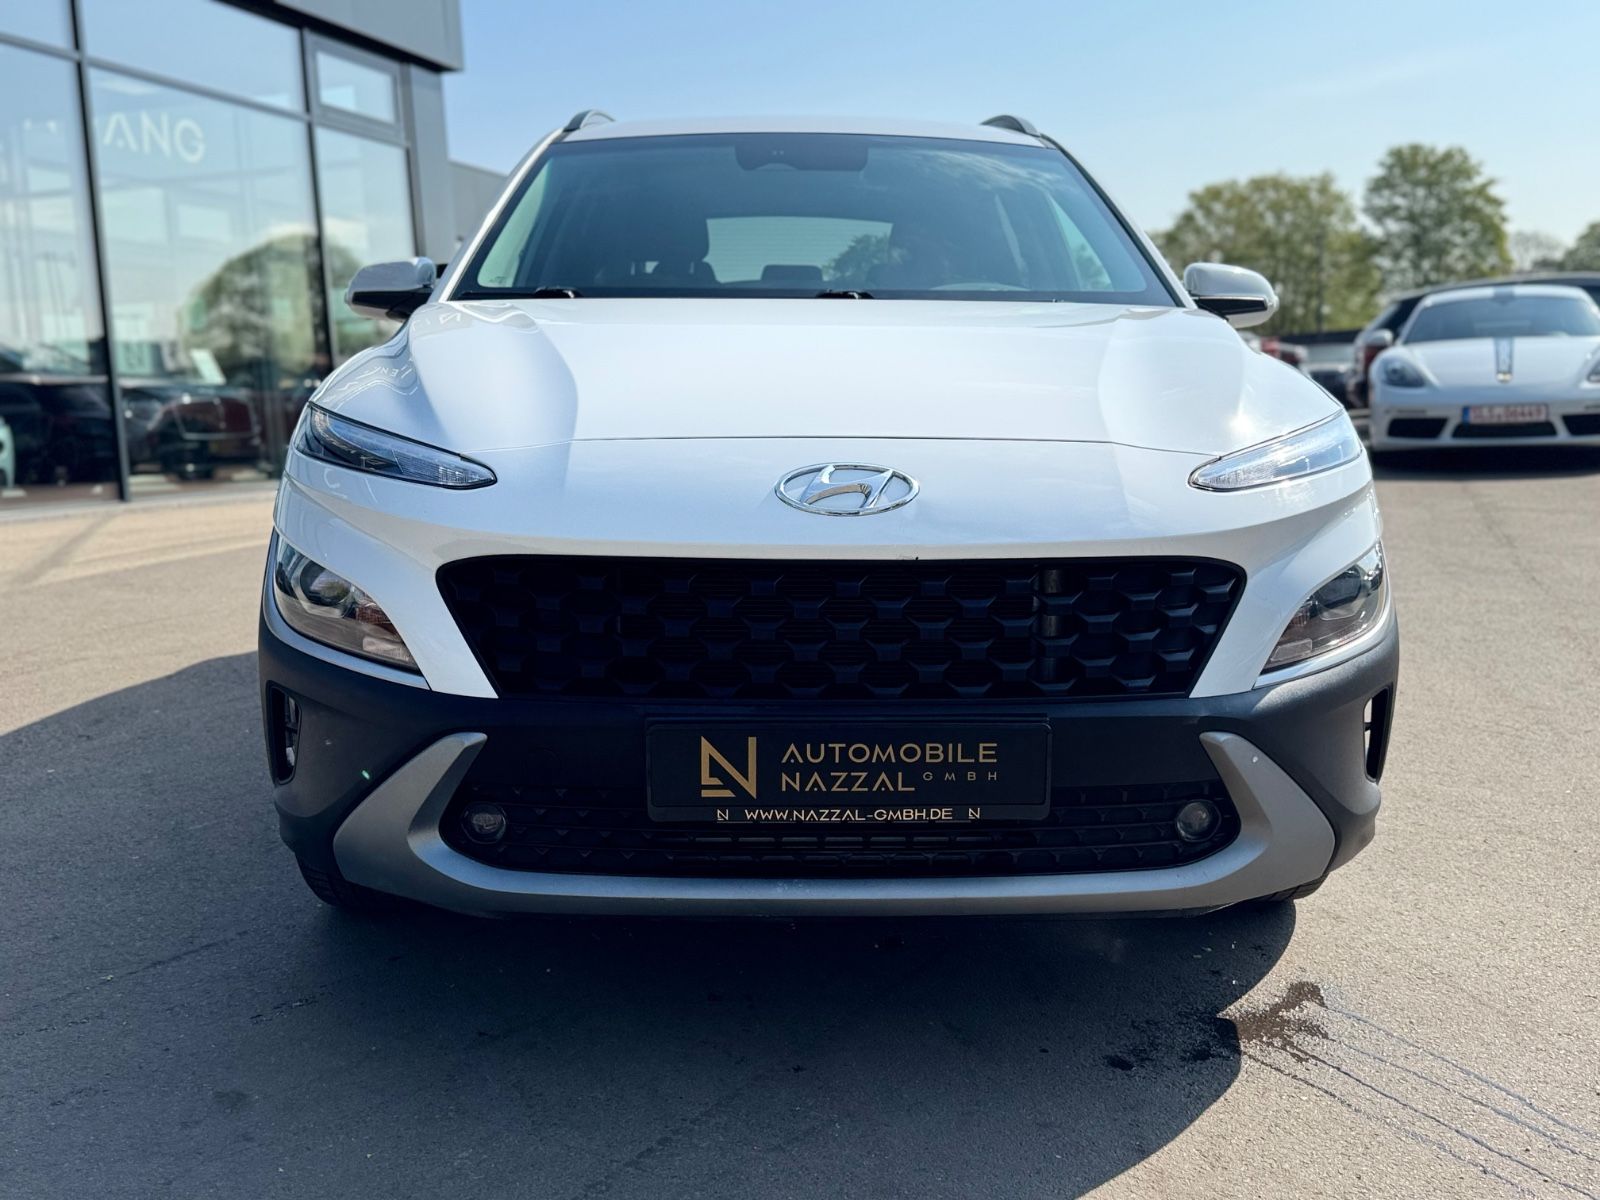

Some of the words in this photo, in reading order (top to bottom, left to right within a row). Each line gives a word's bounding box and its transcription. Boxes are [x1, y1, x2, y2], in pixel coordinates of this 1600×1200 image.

[780, 742, 998, 763] AUTOMOBILE
[781, 771, 916, 792] NAZZAL
[744, 808, 953, 821] WWW.NAZZAL-GMBH.DE
